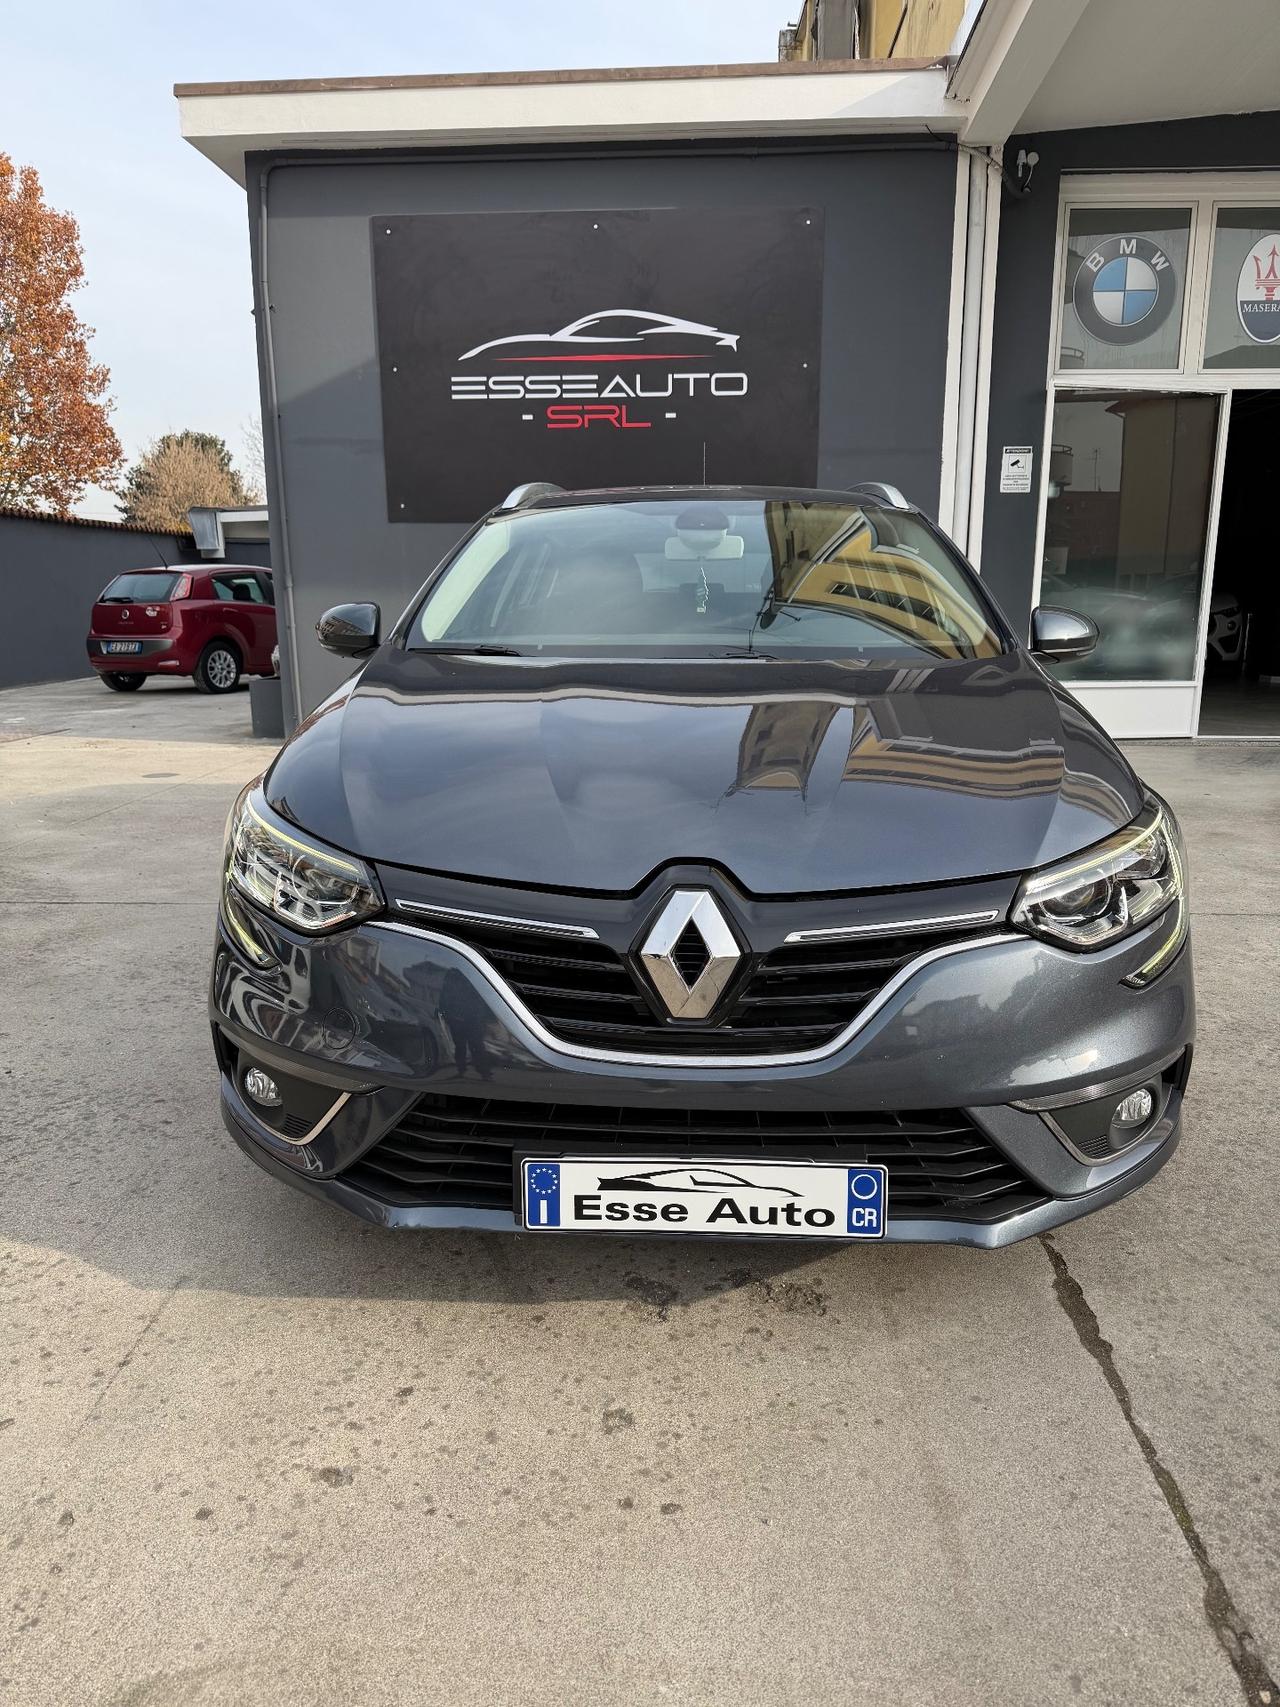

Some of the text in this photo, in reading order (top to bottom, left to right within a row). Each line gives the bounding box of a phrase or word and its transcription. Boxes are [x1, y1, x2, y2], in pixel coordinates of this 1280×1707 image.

[1086, 238, 1170, 272] BMW
[451, 372, 748, 400] ESSEAUTO
[546, 405, 652, 429] SRL
[573, 1194, 836, 1228] Esse Auto
[851, 1207, 878, 1229] CR
